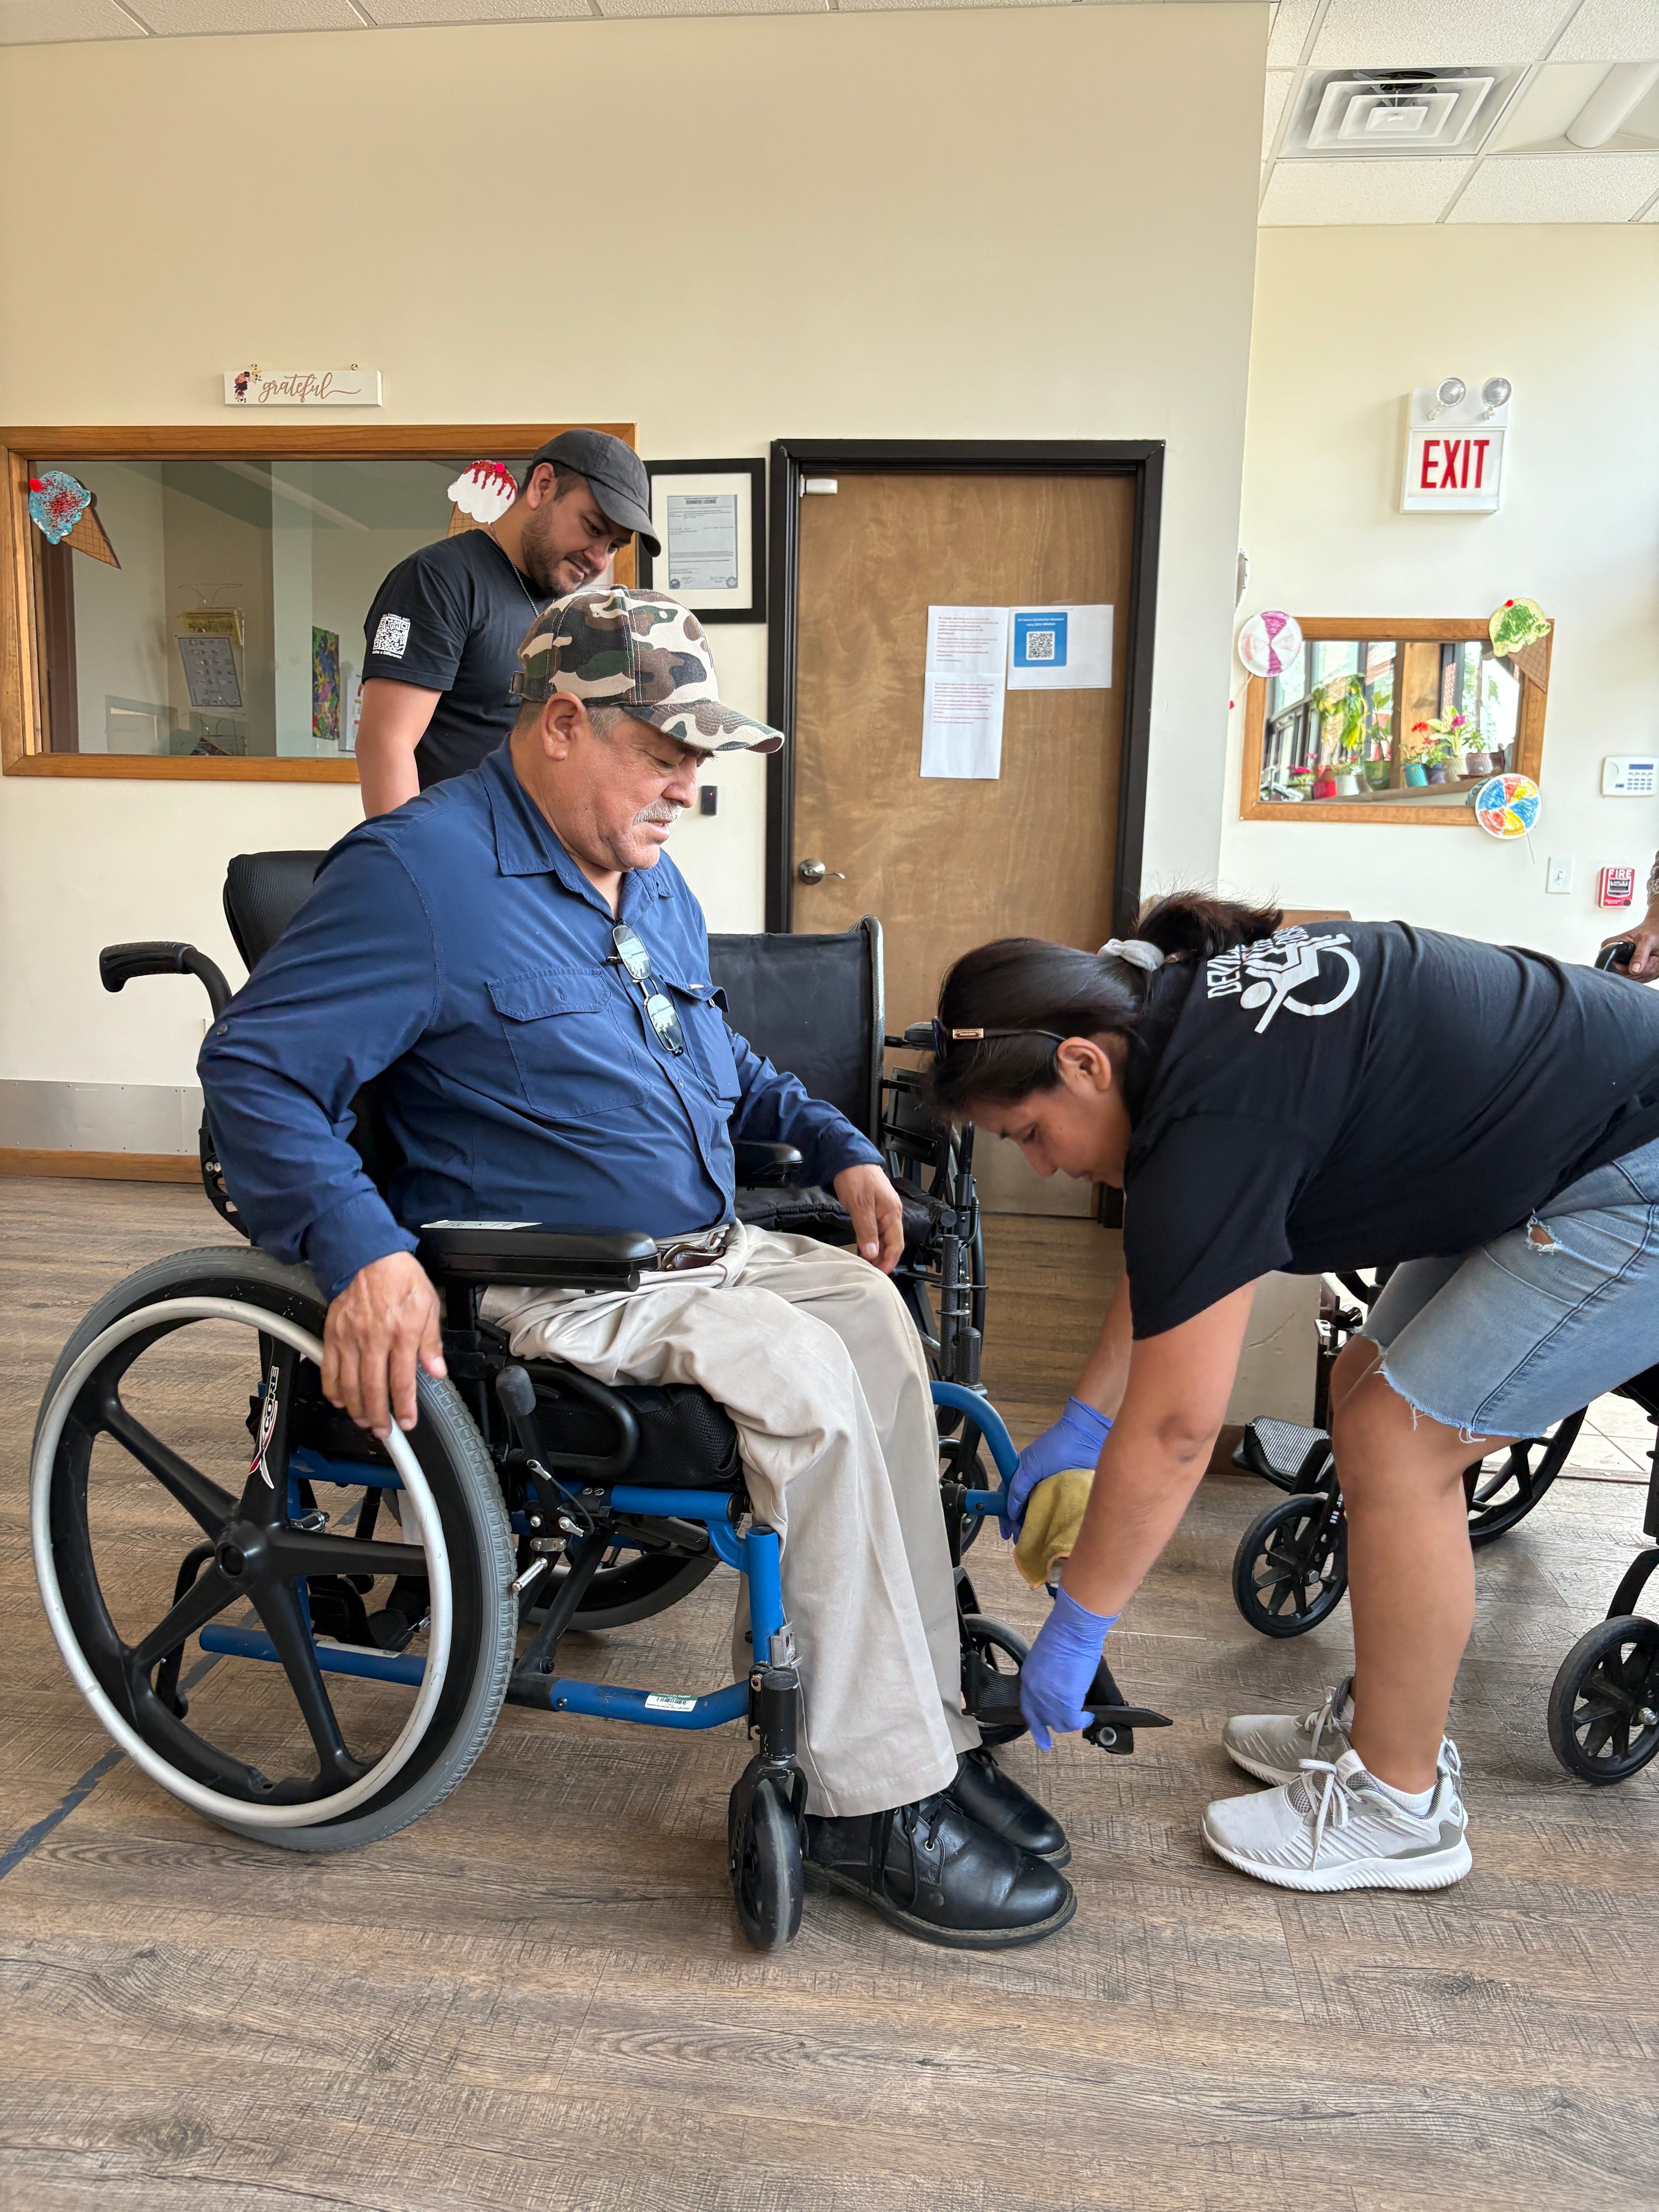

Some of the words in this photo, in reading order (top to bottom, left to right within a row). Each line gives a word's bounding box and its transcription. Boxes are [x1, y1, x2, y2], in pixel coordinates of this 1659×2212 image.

[259, 372, 361, 403] grateful
[1420, 440, 1490, 488] EXIT
[1608, 869, 1632, 879] FIRE
